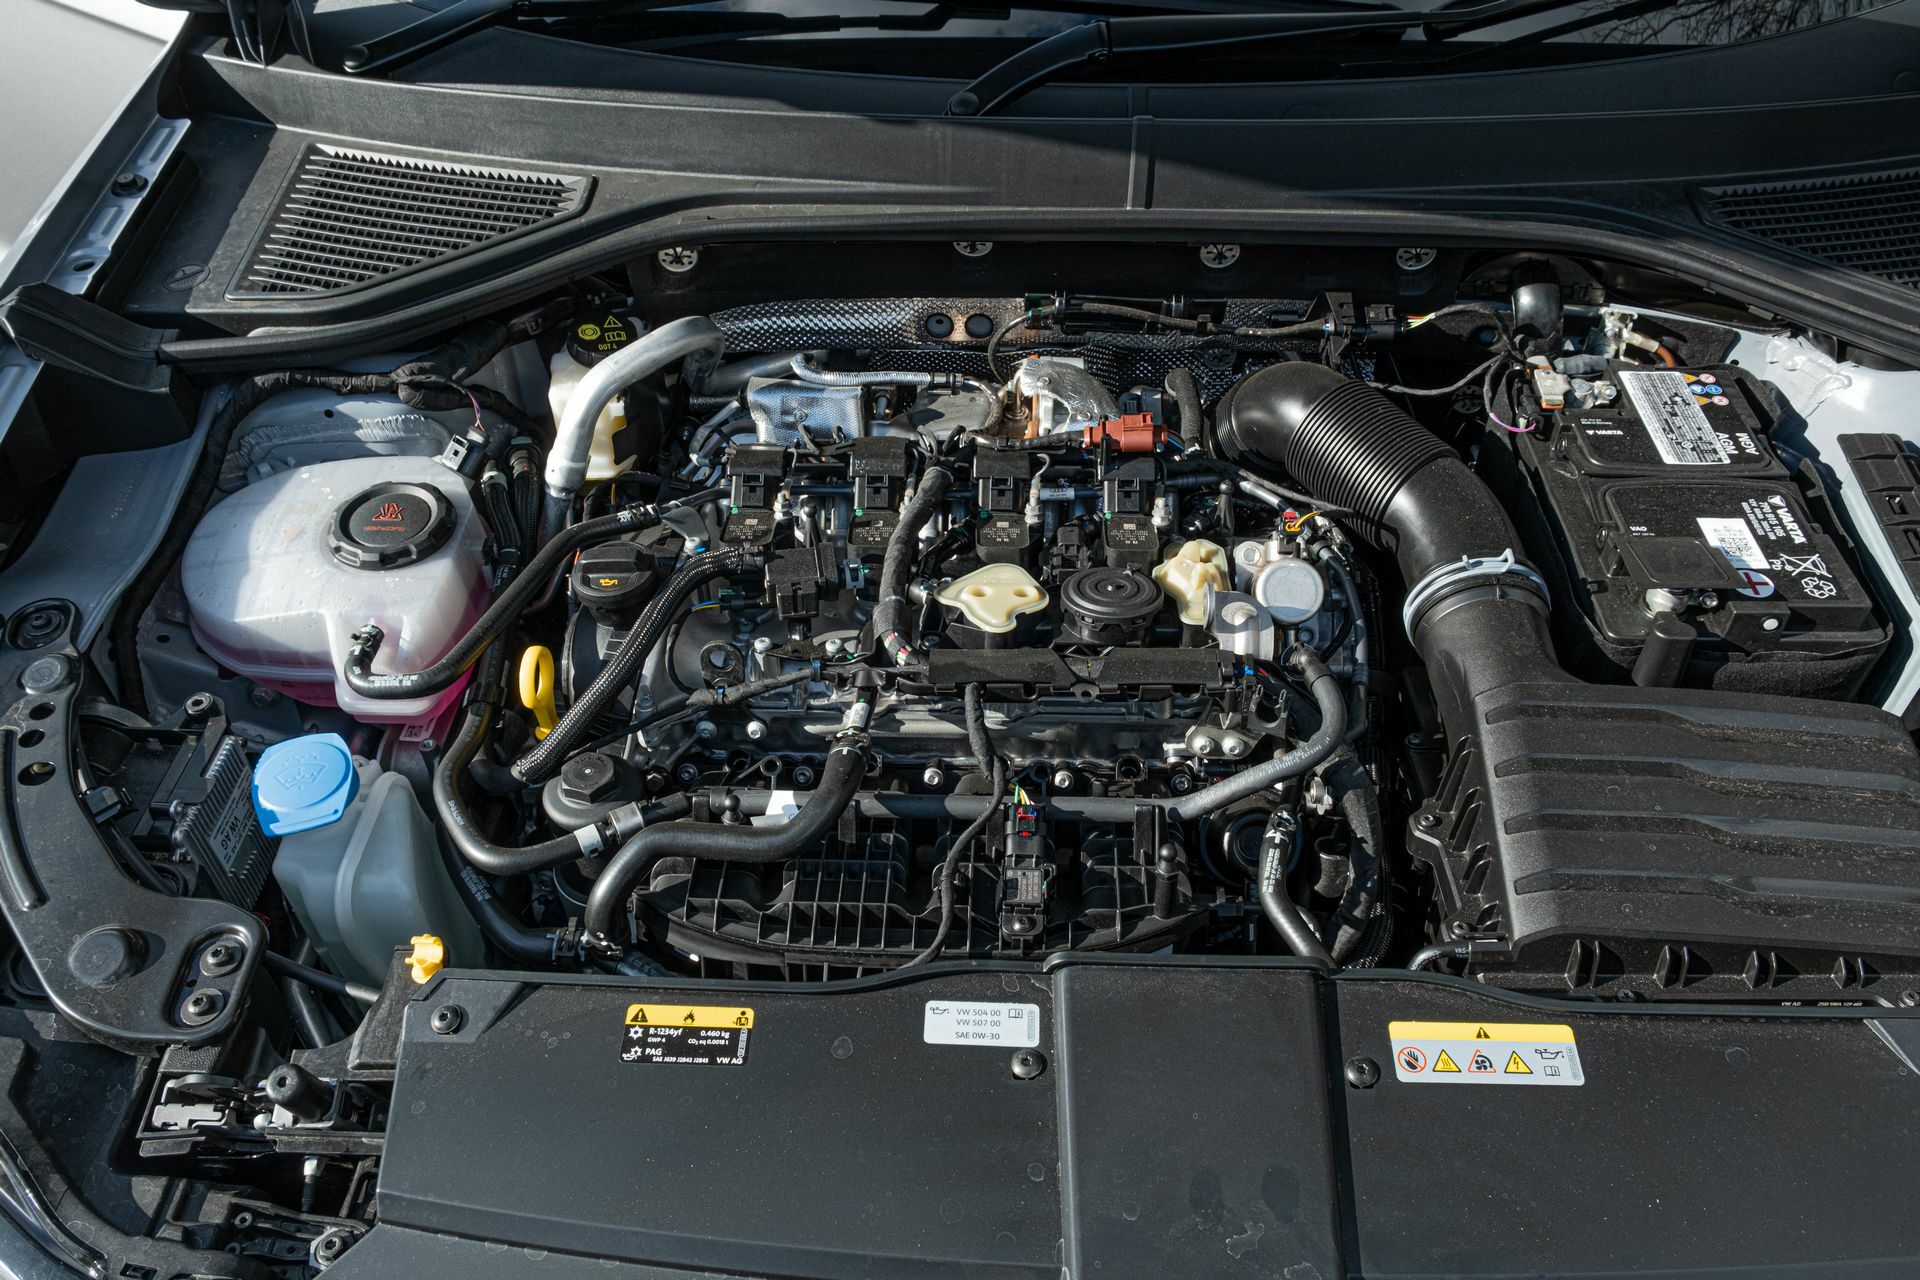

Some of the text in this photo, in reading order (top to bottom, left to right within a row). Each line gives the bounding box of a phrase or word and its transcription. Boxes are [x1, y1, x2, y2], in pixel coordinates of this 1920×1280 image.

[598, 343, 611, 351] DOT
[1715, 432, 1739, 455] AGM
[1736, 432, 1760, 455] AGM
[1776, 508, 1807, 544] VARTA
[1769, 559, 1783, 571] Pb
[221, 815, 240, 850] VW AG
[990, 1009, 1001, 1017] 00
[972, 1019, 988, 1027] 507
[648, 1028, 683, 1037] R-1234yf
[721, 1031, 730, 1039] kg
[972, 1032, 1000, 1040] 0W-30
[645, 1048, 662, 1056] PAG
